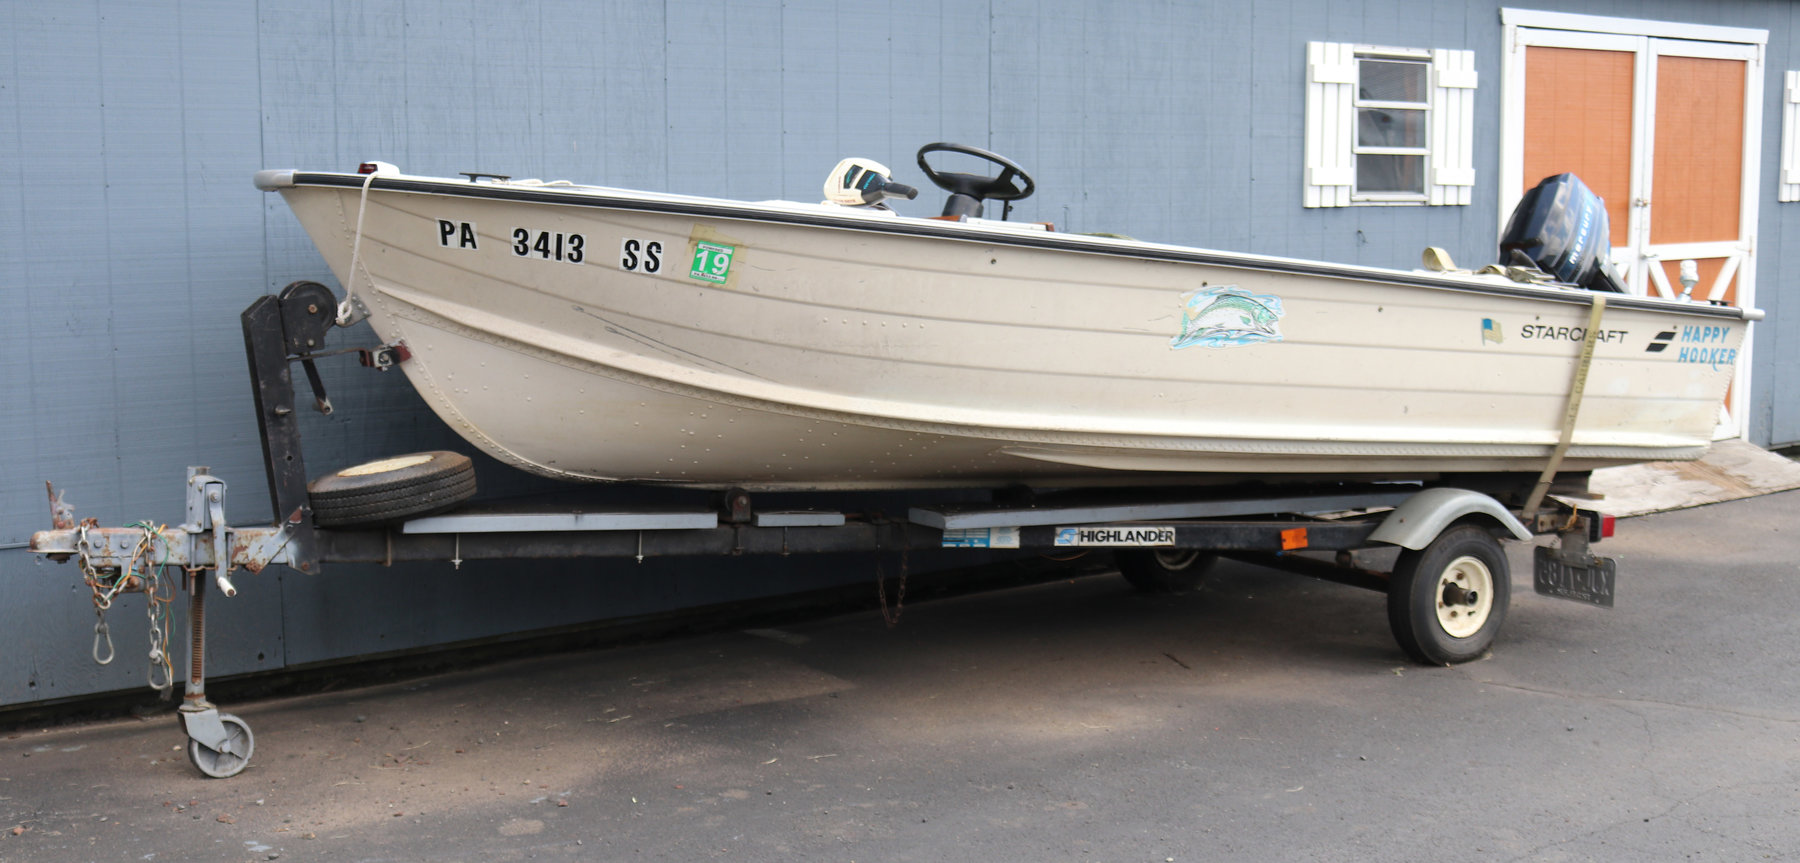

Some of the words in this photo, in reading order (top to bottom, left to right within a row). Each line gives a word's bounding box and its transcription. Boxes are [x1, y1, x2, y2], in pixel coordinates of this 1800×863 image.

[439, 219, 477, 249] PA
[513, 228, 584, 263] 3413
[623, 239, 662, 273] SS
[1569, 206, 1592, 265] mercury
[696, 250, 730, 275] 19
[1680, 325, 1731, 343] HAPPY
[1677, 346, 1737, 372] HOOKER
[1080, 530, 1174, 543] HIGHLANDER
